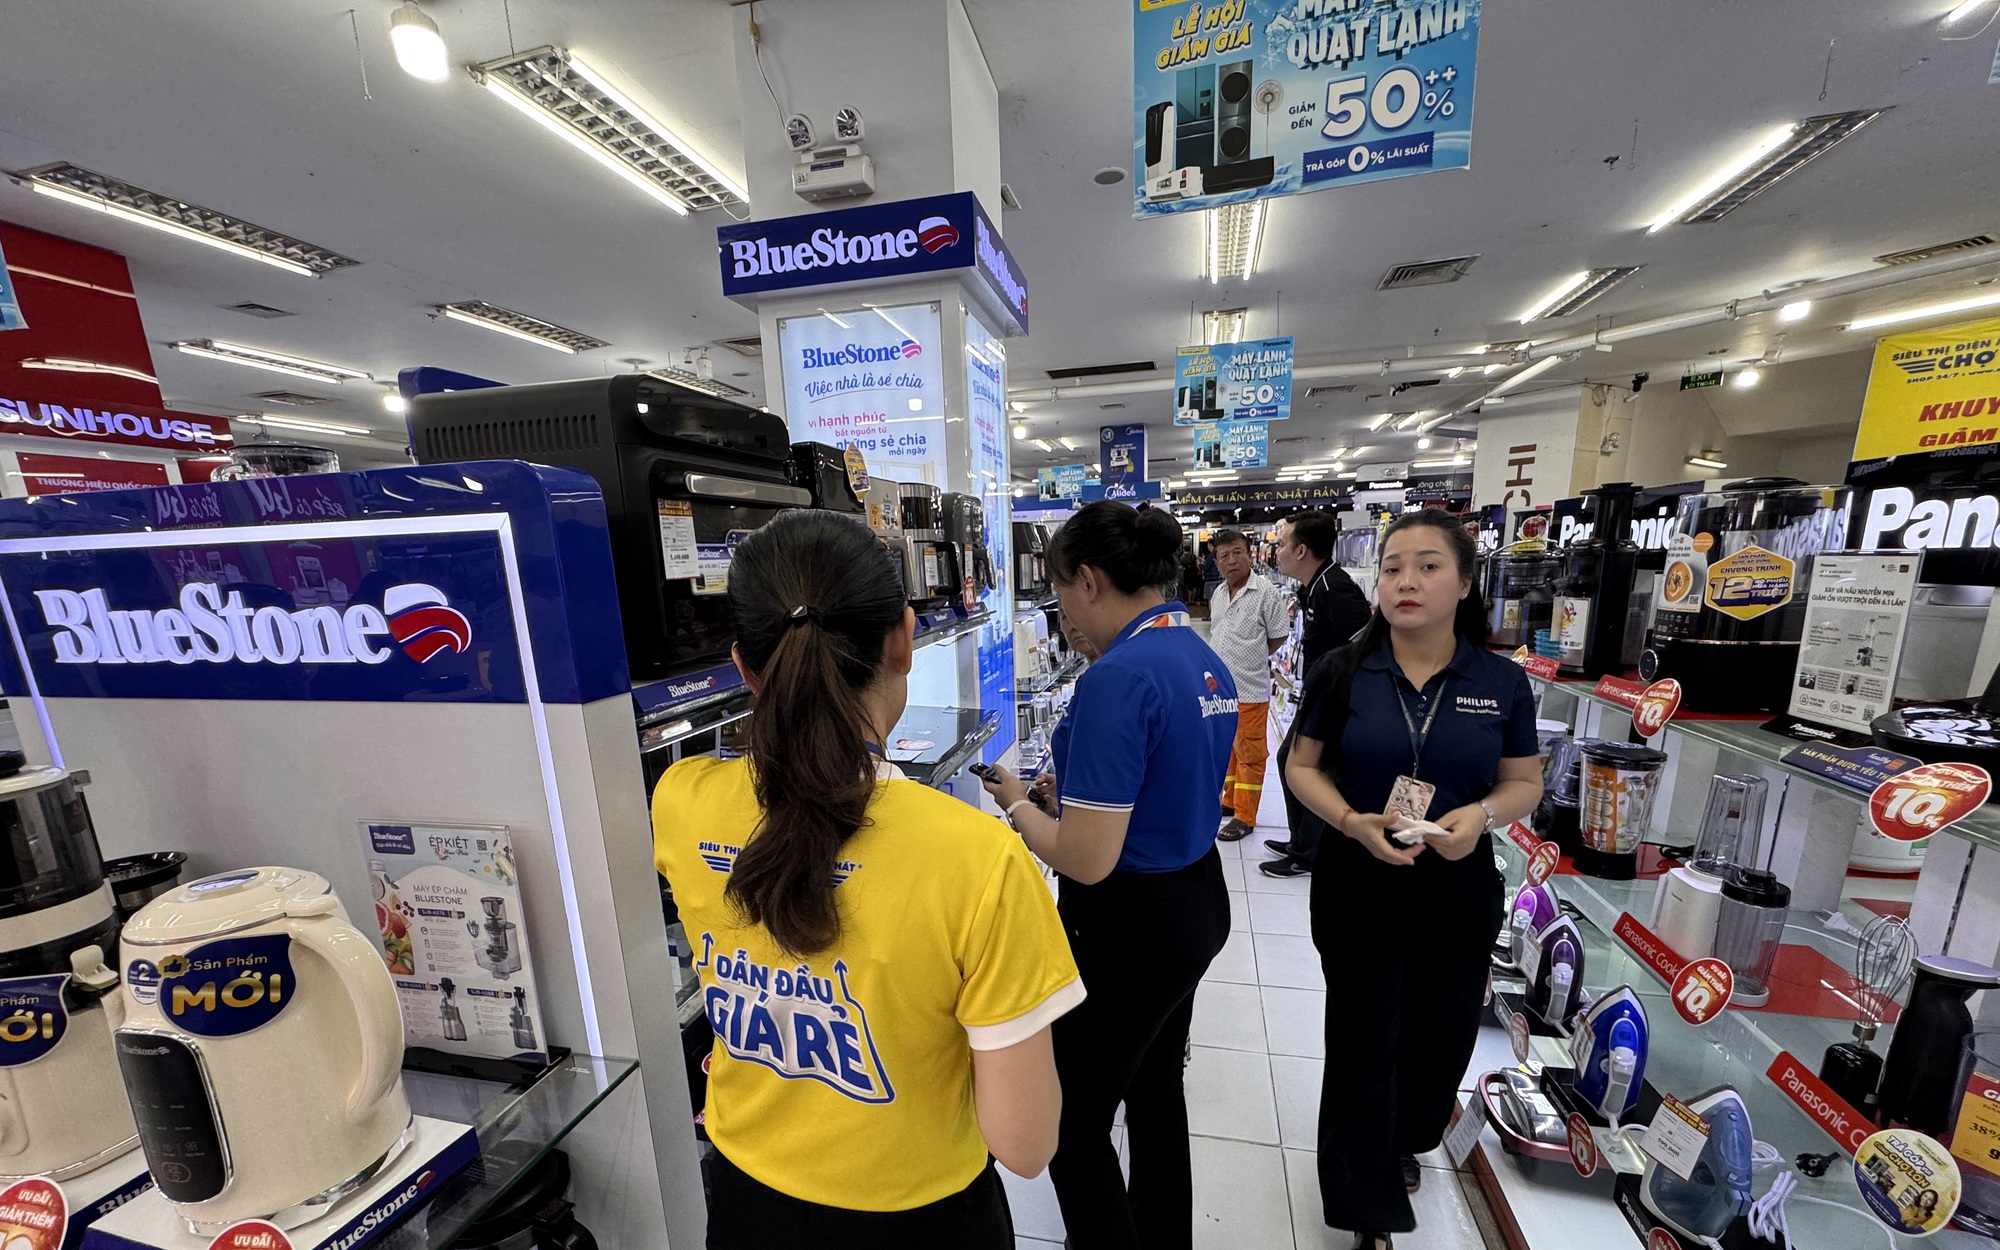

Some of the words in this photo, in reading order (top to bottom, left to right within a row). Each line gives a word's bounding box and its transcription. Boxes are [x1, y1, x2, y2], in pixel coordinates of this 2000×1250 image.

[1172, 4, 1202, 39] LỄ
[1204, 0, 1245, 30] HỘI
[1287, 19, 1370, 69] QUẠT
[1379, 2, 1466, 55] LẠNH
[1156, 36, 1210, 69] GIẢM
[1214, 21, 1252, 53] GIÁ
[1288, 101, 1316, 115] GIẢM
[1290, 115, 1313, 130] ĐẾN
[1306, 161, 1325, 173] TRẢ
[1326, 157, 1345, 171] GÓP
[1386, 147, 1403, 159] LÃI
[1404, 143, 1430, 158] SUẤT
[730, 228, 918, 279] BlueStone
[802, 343, 900, 369] BlueStone
[1232, 352, 1254, 367] MÁY
[1257, 350, 1286, 363] LẠNH
[1892, 350, 1922, 361] SIÊU
[1927, 346, 1949, 356] THỊ
[1955, 339, 1991, 352] ĐIỆN
[1938, 349, 1998, 369] CHỢ
[1229, 366, 1255, 383] QUẠT
[1259, 365, 1287, 382] LẠNH
[1691, 373, 1712, 381] EXIT
[1906, 376, 1933, 384] SHOP
[805, 378, 833, 398] Việc
[835, 374, 860, 391] nhà
[862, 372, 876, 387] là
[895, 373, 924, 389] chia
[0, 398, 215, 445] SUNHOUSE
[819, 413, 850, 428] hạnh
[854, 411, 886, 427] phúc
[851, 427, 876, 438] nguồn
[878, 426, 887, 436] từ
[899, 434, 926, 447] chia
[1919, 427, 1998, 447] GIẢM
[907, 447, 926, 457] ngày
[36, 477, 85, 488] THƯƠNG
[1105, 485, 1136, 499] Midea
[1204, 491, 1246, 503] CHUẨN
[1276, 489, 1309, 502] NHẬT
[1313, 486, 1339, 498] BẢN
[1755, 564, 1781, 572] TRÌNH
[1709, 576, 1753, 600] 12
[1751, 588, 1787, 598] TRIỆU
[1836, 586, 1844, 594] VÀ
[1844, 586, 1856, 594] NẤU
[1857, 587, 1881, 596] NHUYỄN
[1882, 589, 1895, 597] MỊN
[1837, 595, 1852, 604] VƯỢT
[1853, 596, 1867, 605] TRỘI
[1868, 596, 1881, 605] ĐẾN
[33, 581, 392, 665] BlueStone
[667, 680, 710, 697] BlueStone
[1198, 694, 1239, 718] BlueStone
[1456, 696, 1498, 708] PHILIPS
[1790, 723, 1836, 739] Panasonic
[1801, 748, 1819, 758] SẢN
[1817, 752, 1838, 764] PHẨM
[1836, 758, 1860, 770] ĐƯỢC
[1860, 765, 1876, 775] YÊU
[698, 842, 720, 852] SIÊU
[414, 894, 462, 905] BLUESTONE
[1620, 922, 1656, 959] Panasonic
[194, 958, 221, 970] Sản
[226, 954, 268, 968] Phẩm
[716, 950, 769, 992] DẪN
[774, 965, 834, 1004] ĐẦU
[172, 970, 282, 1016] MỚI
[705, 986, 786, 1068] GIÁ
[793, 1004, 876, 1091] RẺ
[1781, 1067, 1849, 1135] Panasonic
[1886, 1135, 1908, 1152] TRẢ
[1903, 1148, 1926, 1168] GÓP
[1888, 1153, 1911, 1172] CHỢ
[1906, 1170, 1931, 1188] LỚN
[18, 1189, 33, 1201] ƯU
[33, 1190, 51, 1204] ĐÃI
[0, 1204, 25, 1222] GIẢM
[23, 1210, 57, 1228] THÊM
[234, 1232, 253, 1247] ƯU
[253, 1231, 271, 1247] ĐÃI
